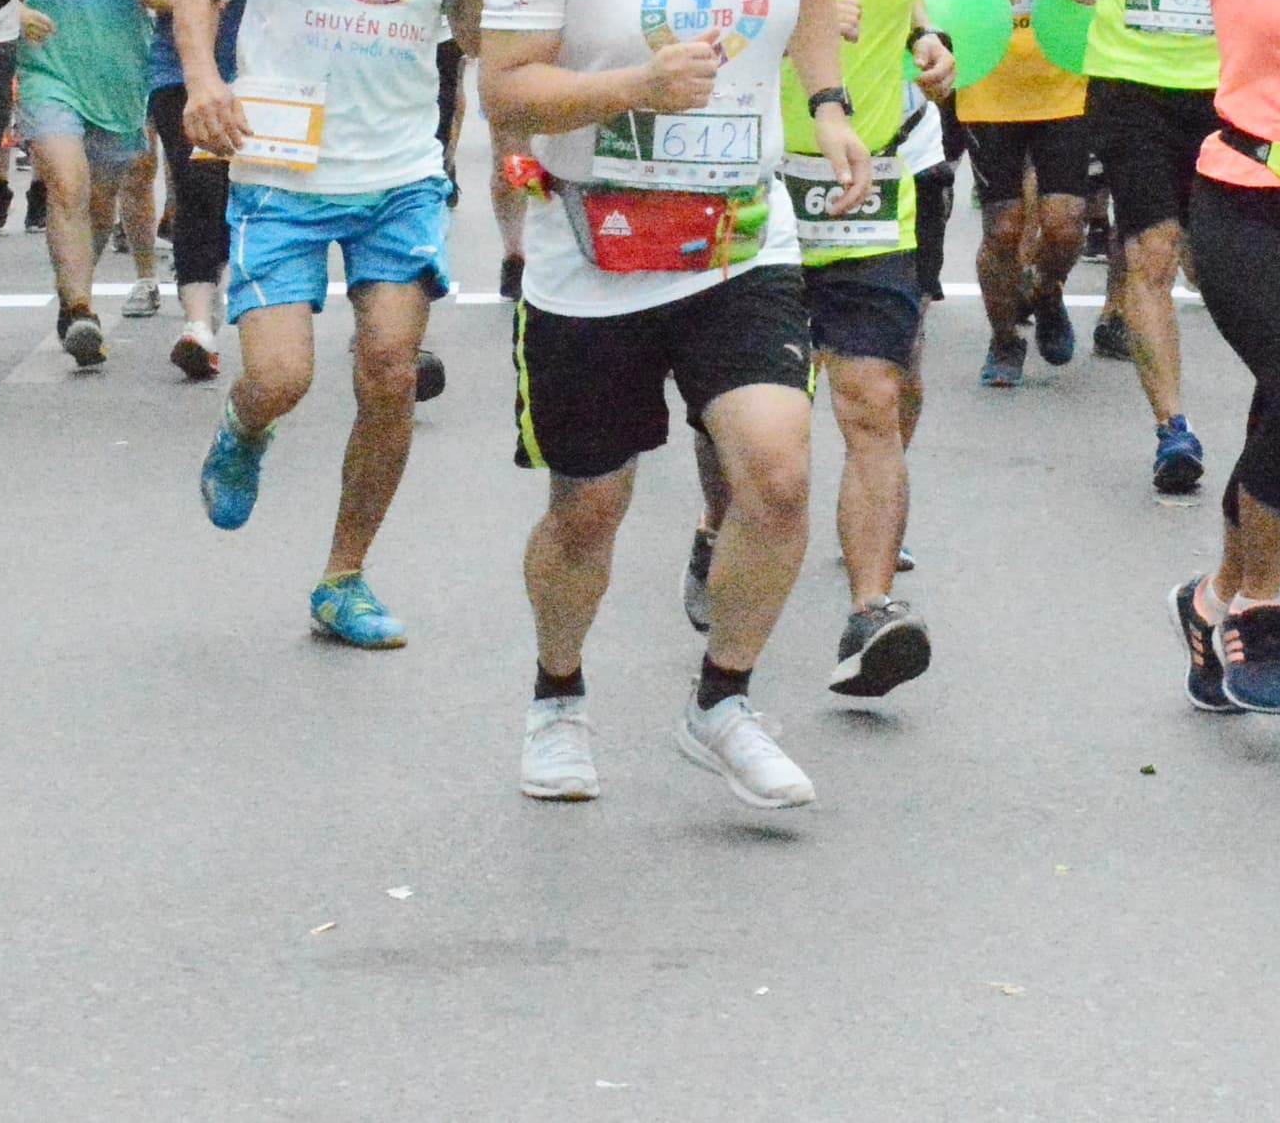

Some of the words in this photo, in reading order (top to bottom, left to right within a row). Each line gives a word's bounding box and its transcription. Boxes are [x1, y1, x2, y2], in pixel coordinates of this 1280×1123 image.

[673, 11, 709, 30] END
[712, 8, 733, 27] TB
[662, 121, 754, 161] 6121
[805, 186, 881, 215] 605
